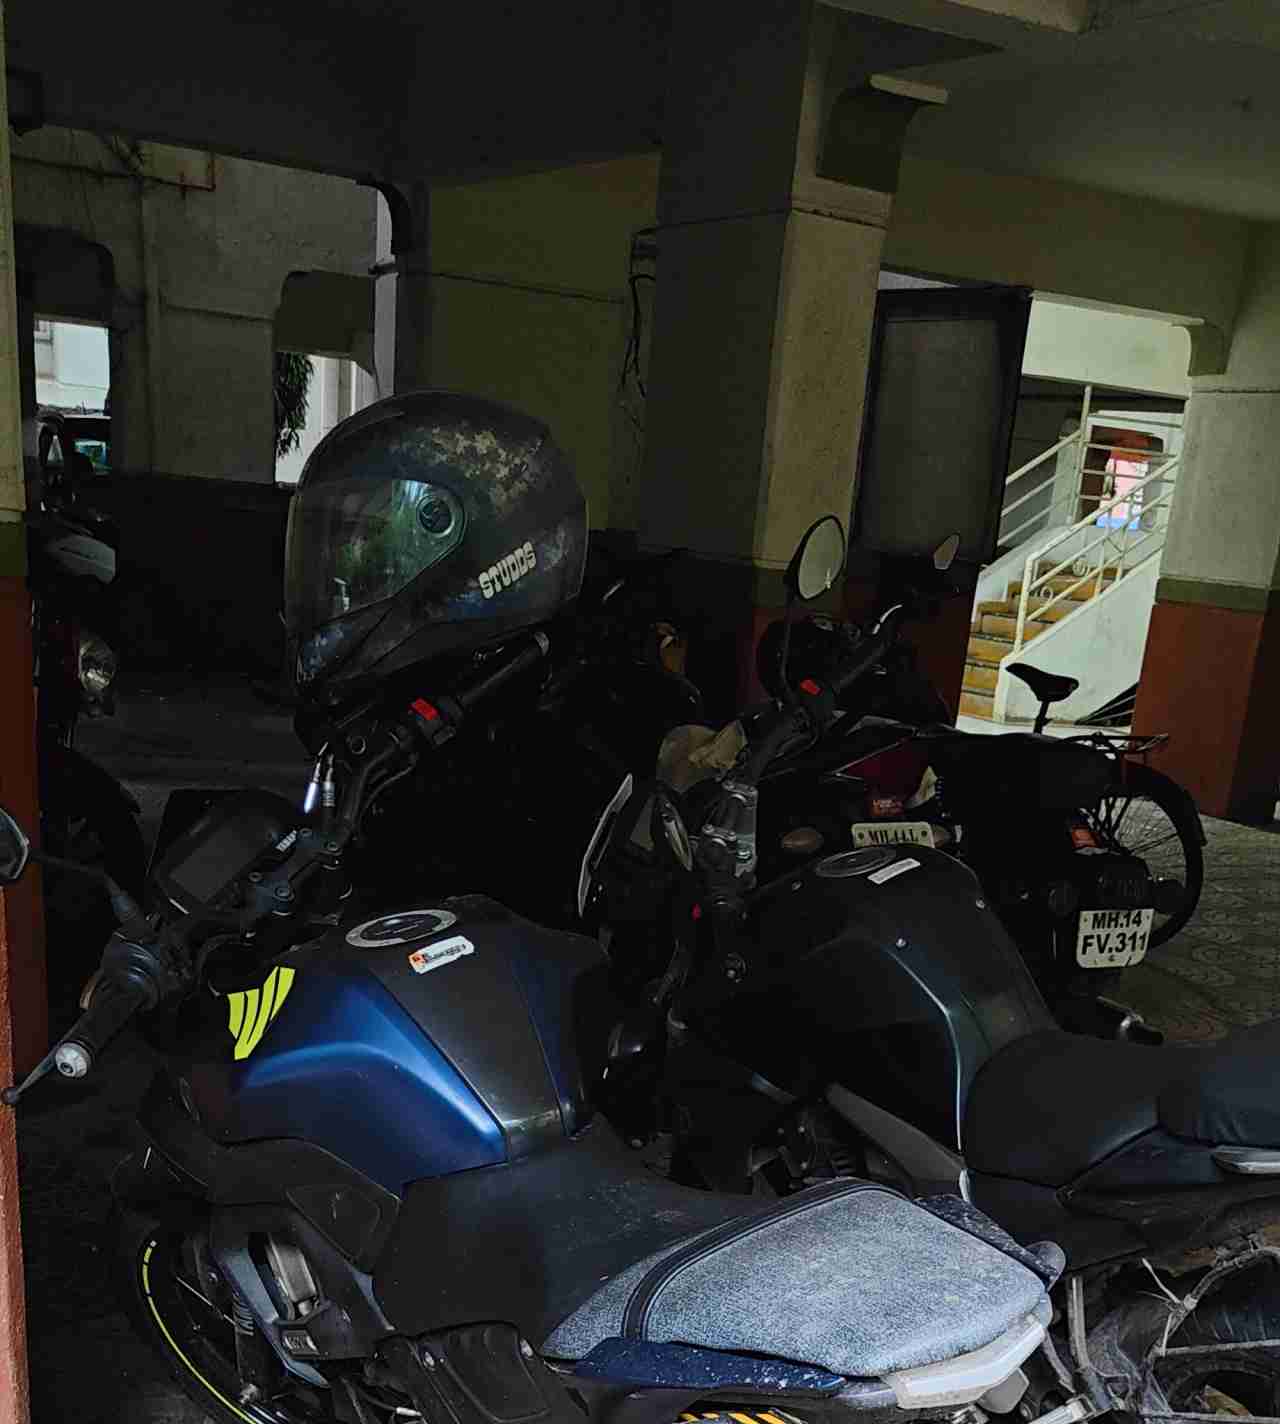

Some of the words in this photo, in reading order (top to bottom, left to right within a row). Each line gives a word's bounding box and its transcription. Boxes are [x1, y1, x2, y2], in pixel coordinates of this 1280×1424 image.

[478, 541, 537, 599] STUDDS
[1091, 910, 1143, 930] MH.14
[1081, 931, 1148, 956] FV.311
